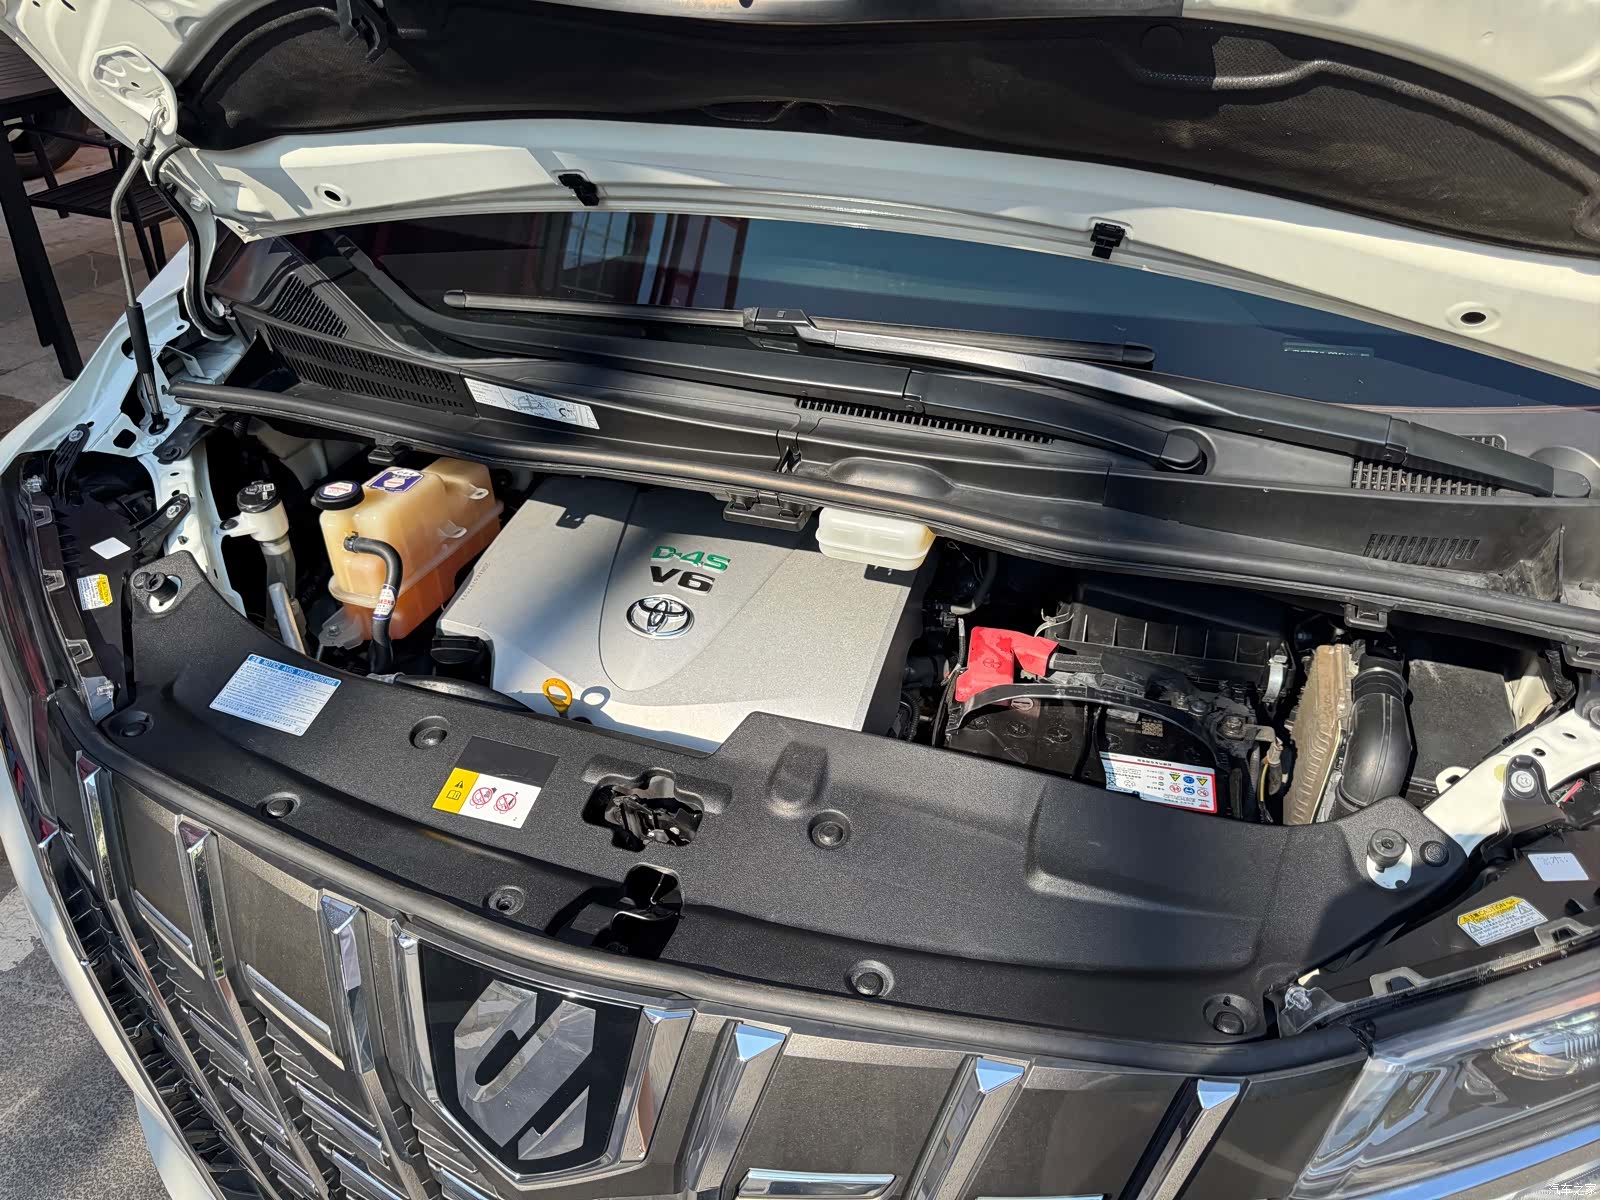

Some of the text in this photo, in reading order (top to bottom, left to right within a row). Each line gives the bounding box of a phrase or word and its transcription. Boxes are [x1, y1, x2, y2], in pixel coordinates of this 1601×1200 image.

[651, 545, 731, 571] D-4S
[650, 565, 716, 594] V6
[263, 658, 281, 669] NOTICE
